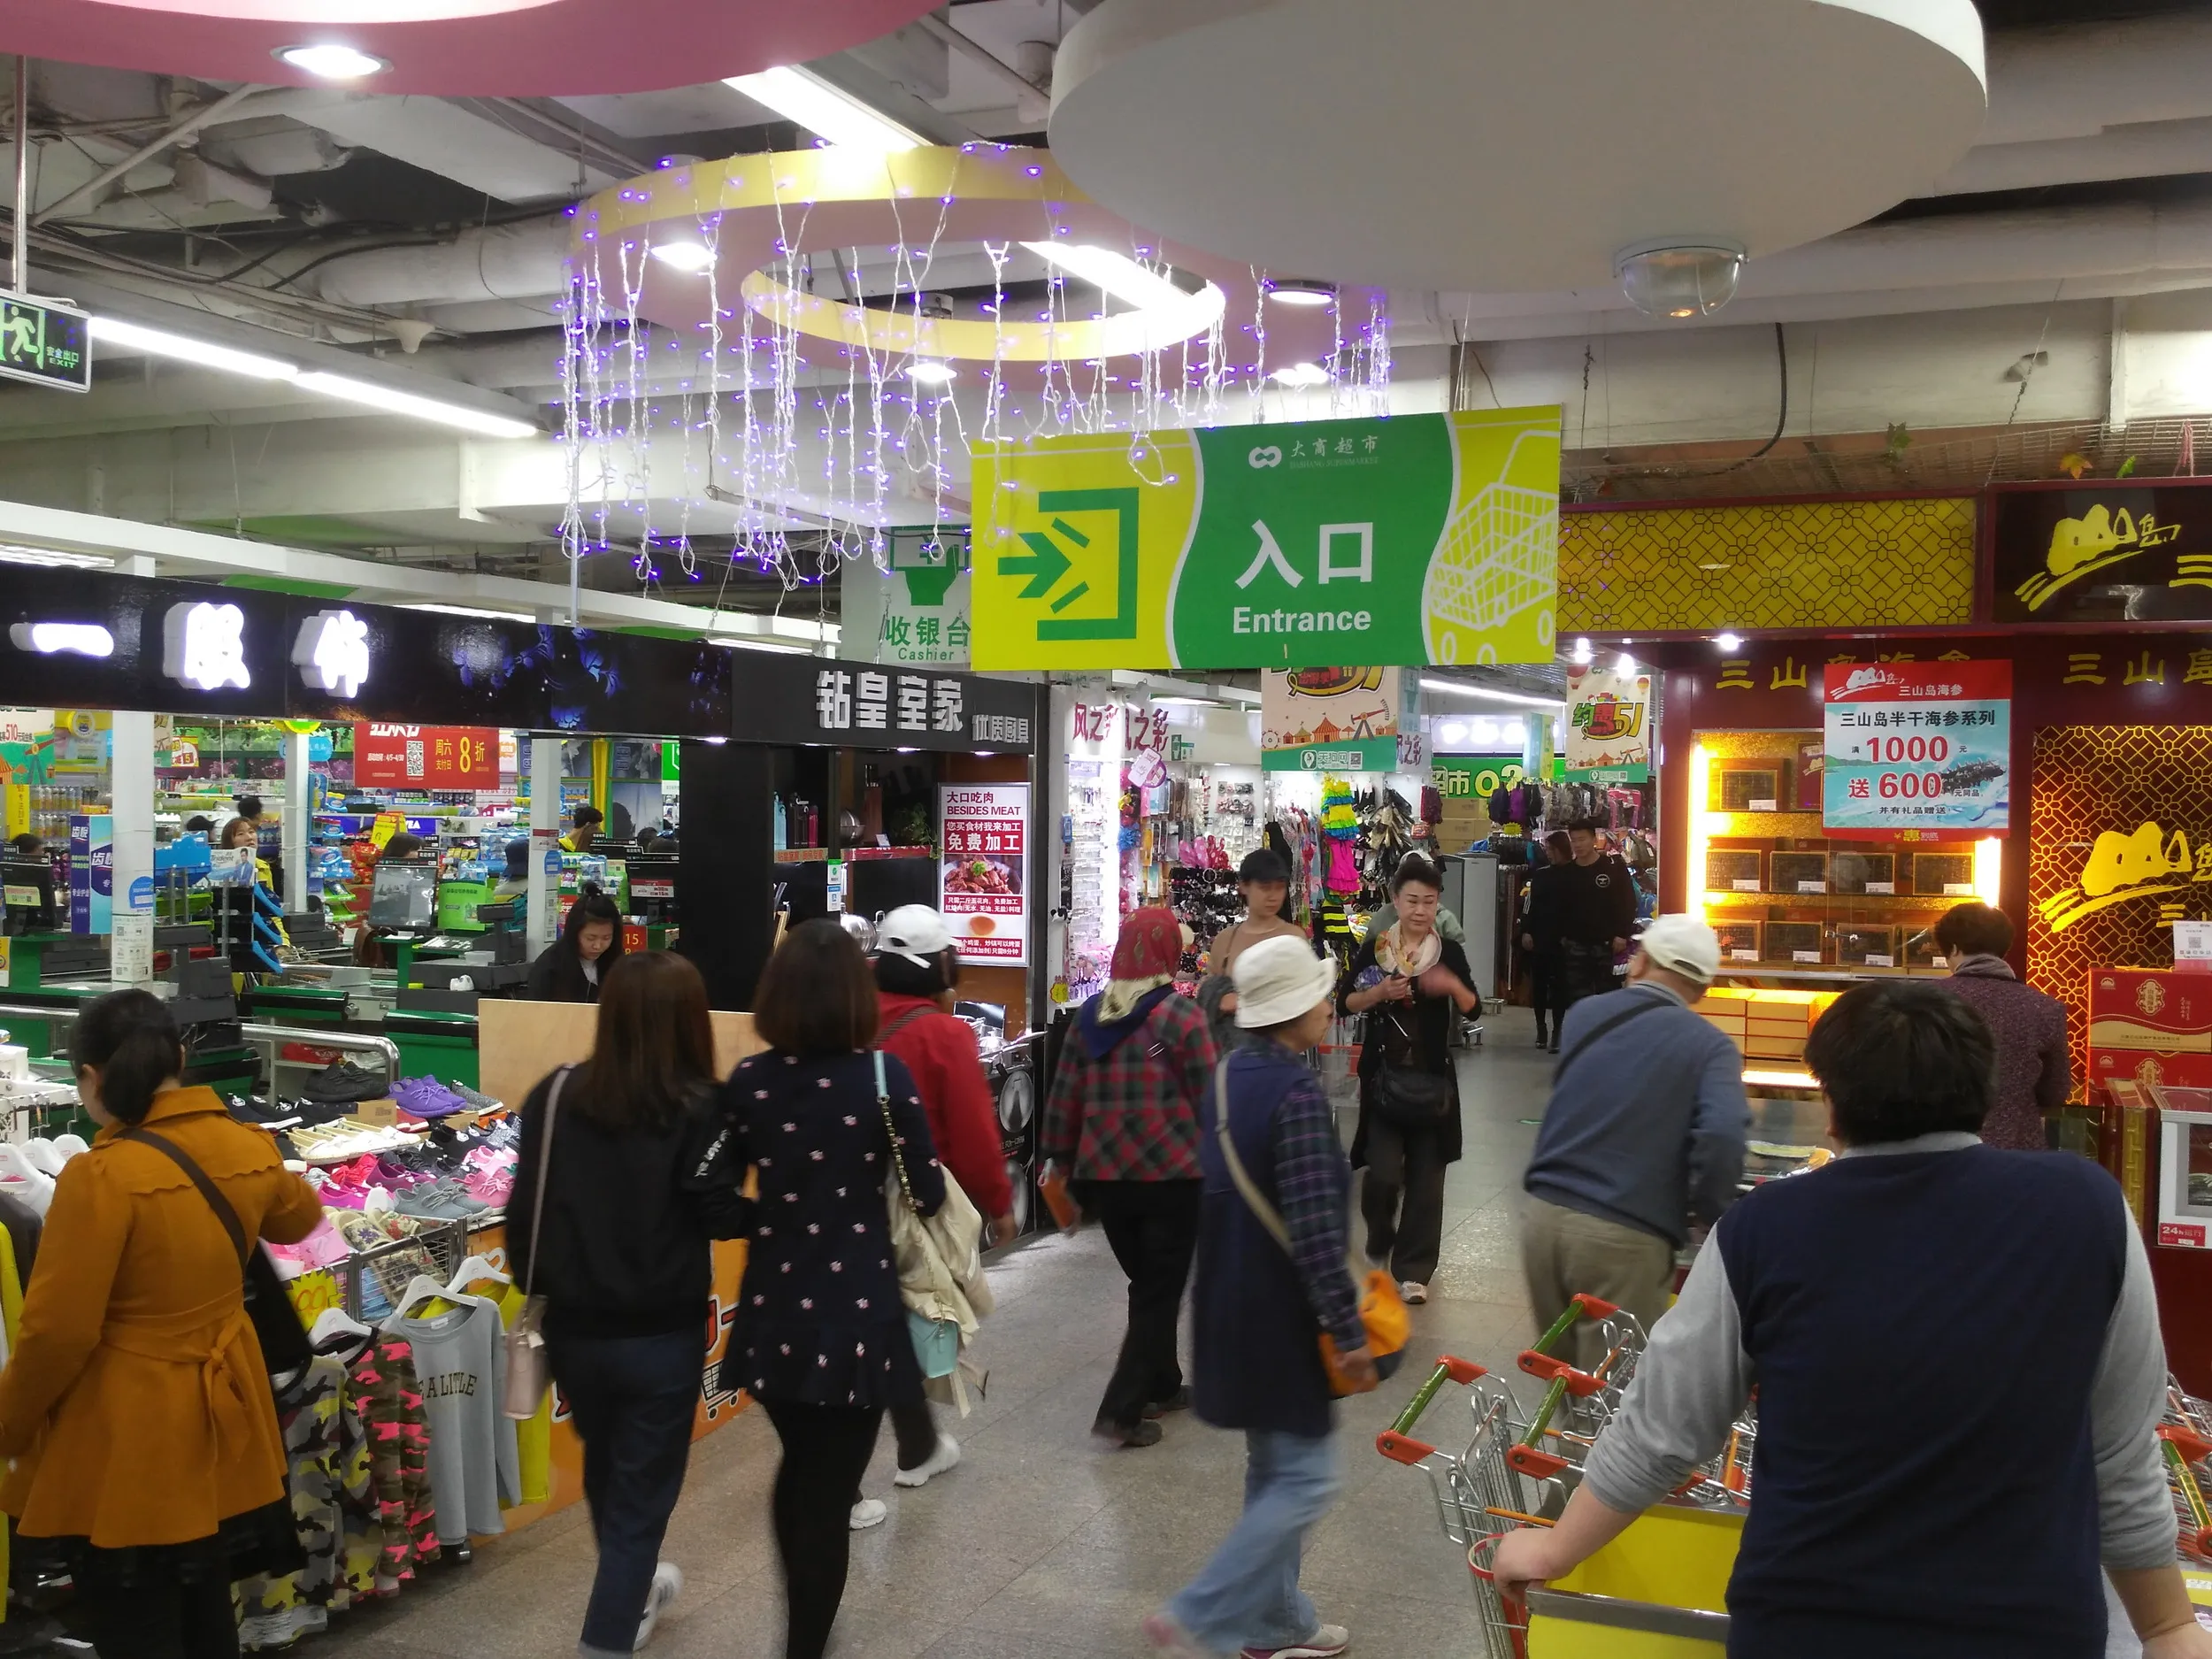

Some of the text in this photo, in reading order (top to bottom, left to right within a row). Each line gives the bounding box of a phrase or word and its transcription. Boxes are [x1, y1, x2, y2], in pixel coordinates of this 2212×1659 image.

[46, 346, 80, 363] 安全出口
[49, 357, 76, 369] EXIT
[1291, 434, 1379, 457] 大商超市
[1234, 520, 1375, 590] 入口
[1232, 606, 1372, 634] Entrance
[885, 615, 972, 648] 收银台
[897, 647, 955, 662] Cashier
[1899, 684, 1963, 697] 三山岛海参
[1839, 710, 1996, 727] 三山岛半干海参系列
[972, 713, 1029, 744] 优质厨具
[435, 736, 486, 773] 周六 8 折
[1866, 735, 1948, 763] 1000
[1959, 744, 1968, 753] 元
[1847, 778, 1870, 799] 送
[1878, 771, 1942, 800] 600
[947, 791, 995, 804] 大口吃肉
[947, 806, 1021, 816] BESIDES MEAT
[947, 821, 1022, 832] 您买食材我来加工
[948, 833, 1020, 852] 免费加工
